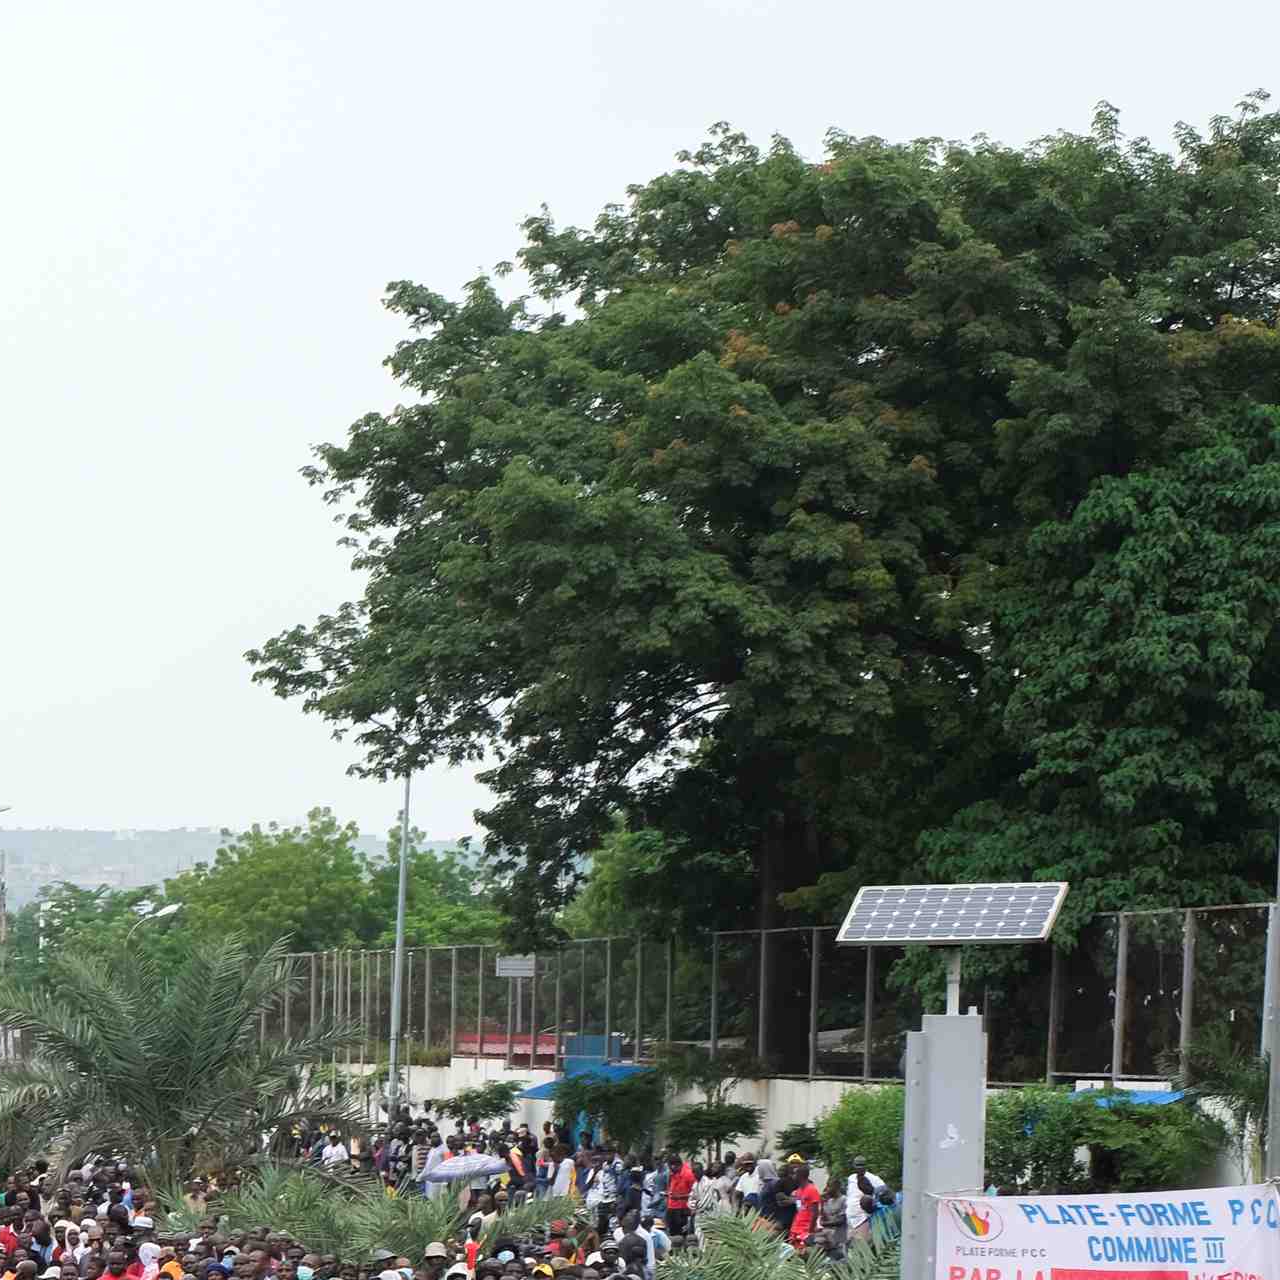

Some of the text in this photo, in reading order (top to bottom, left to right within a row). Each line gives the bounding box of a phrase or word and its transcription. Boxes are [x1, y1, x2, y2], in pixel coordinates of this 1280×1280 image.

[1019, 1201, 1211, 1226] PLATE-FORME
[1087, 1235, 1225, 1263] COMMUNE III
